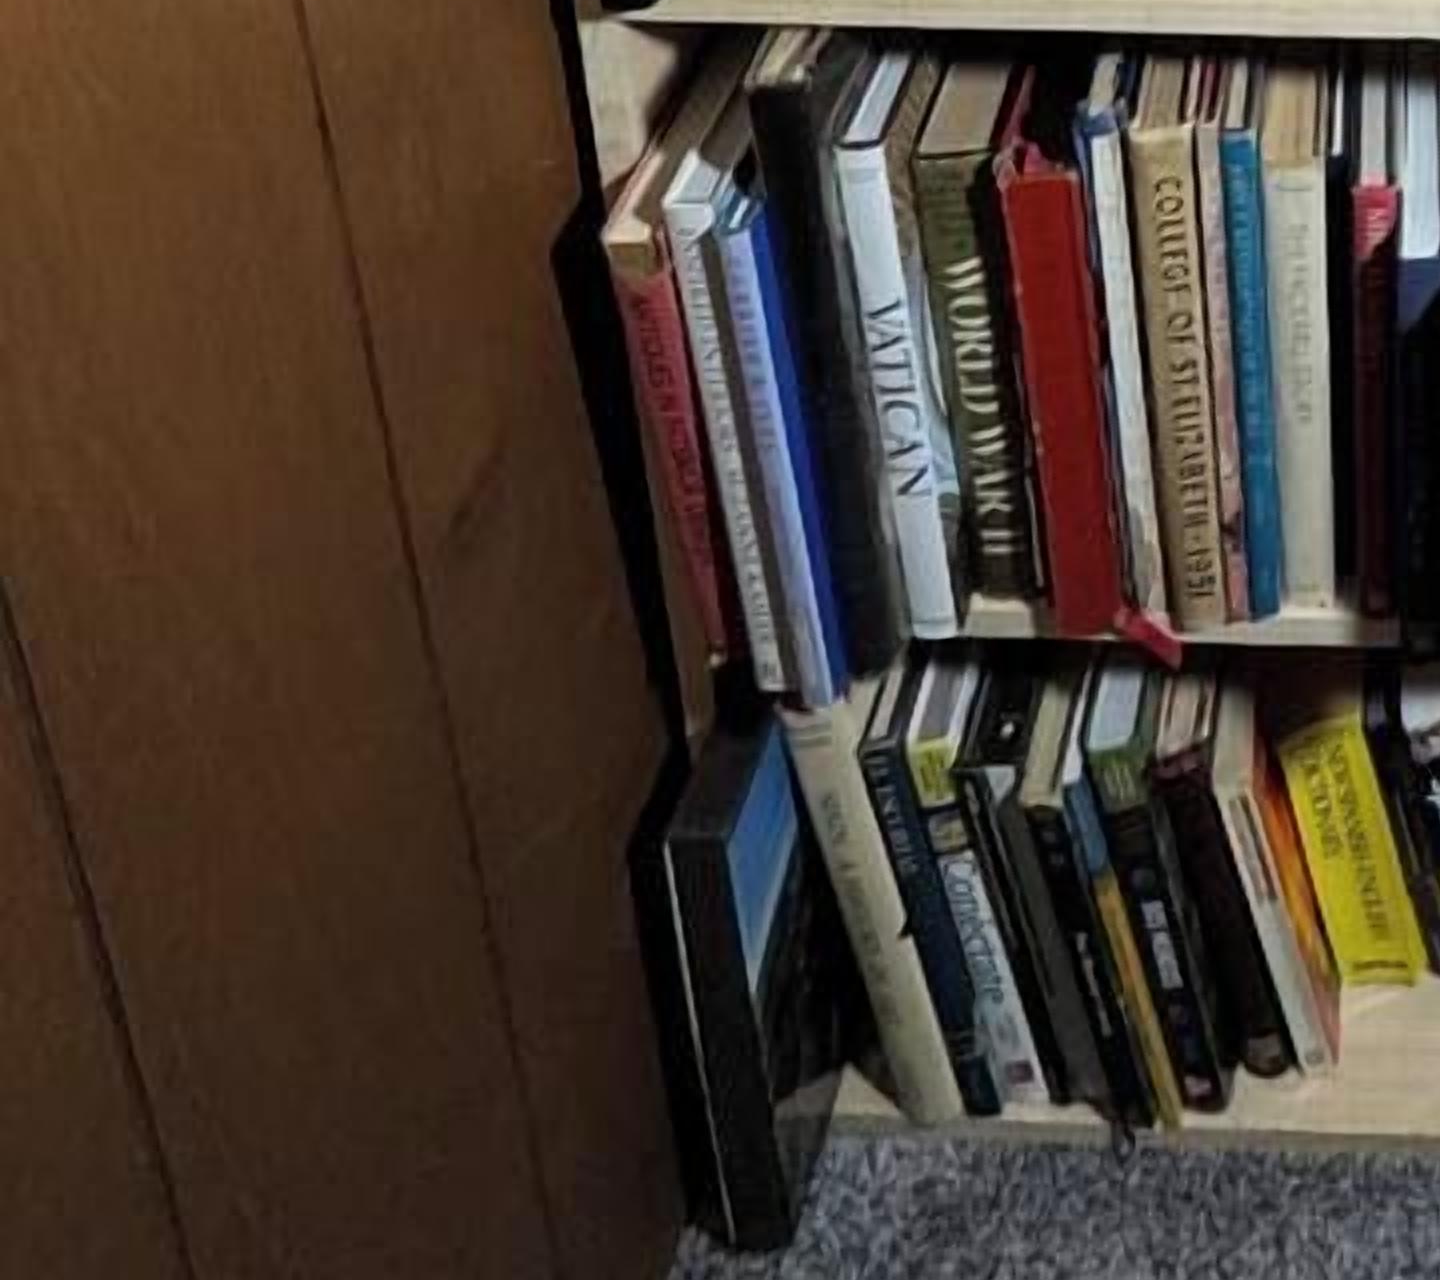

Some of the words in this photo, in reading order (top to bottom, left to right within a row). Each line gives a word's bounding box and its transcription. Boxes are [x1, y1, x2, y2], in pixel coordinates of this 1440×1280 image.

[1151, 175, 1190, 292] COLLEGE
[941, 254, 1000, 412] WORLD
[1167, 311, 1195, 345] OF
[864, 296, 932, 500] VATICAN
[967, 423, 1016, 514] WAR
[978, 526, 1024, 557] II
